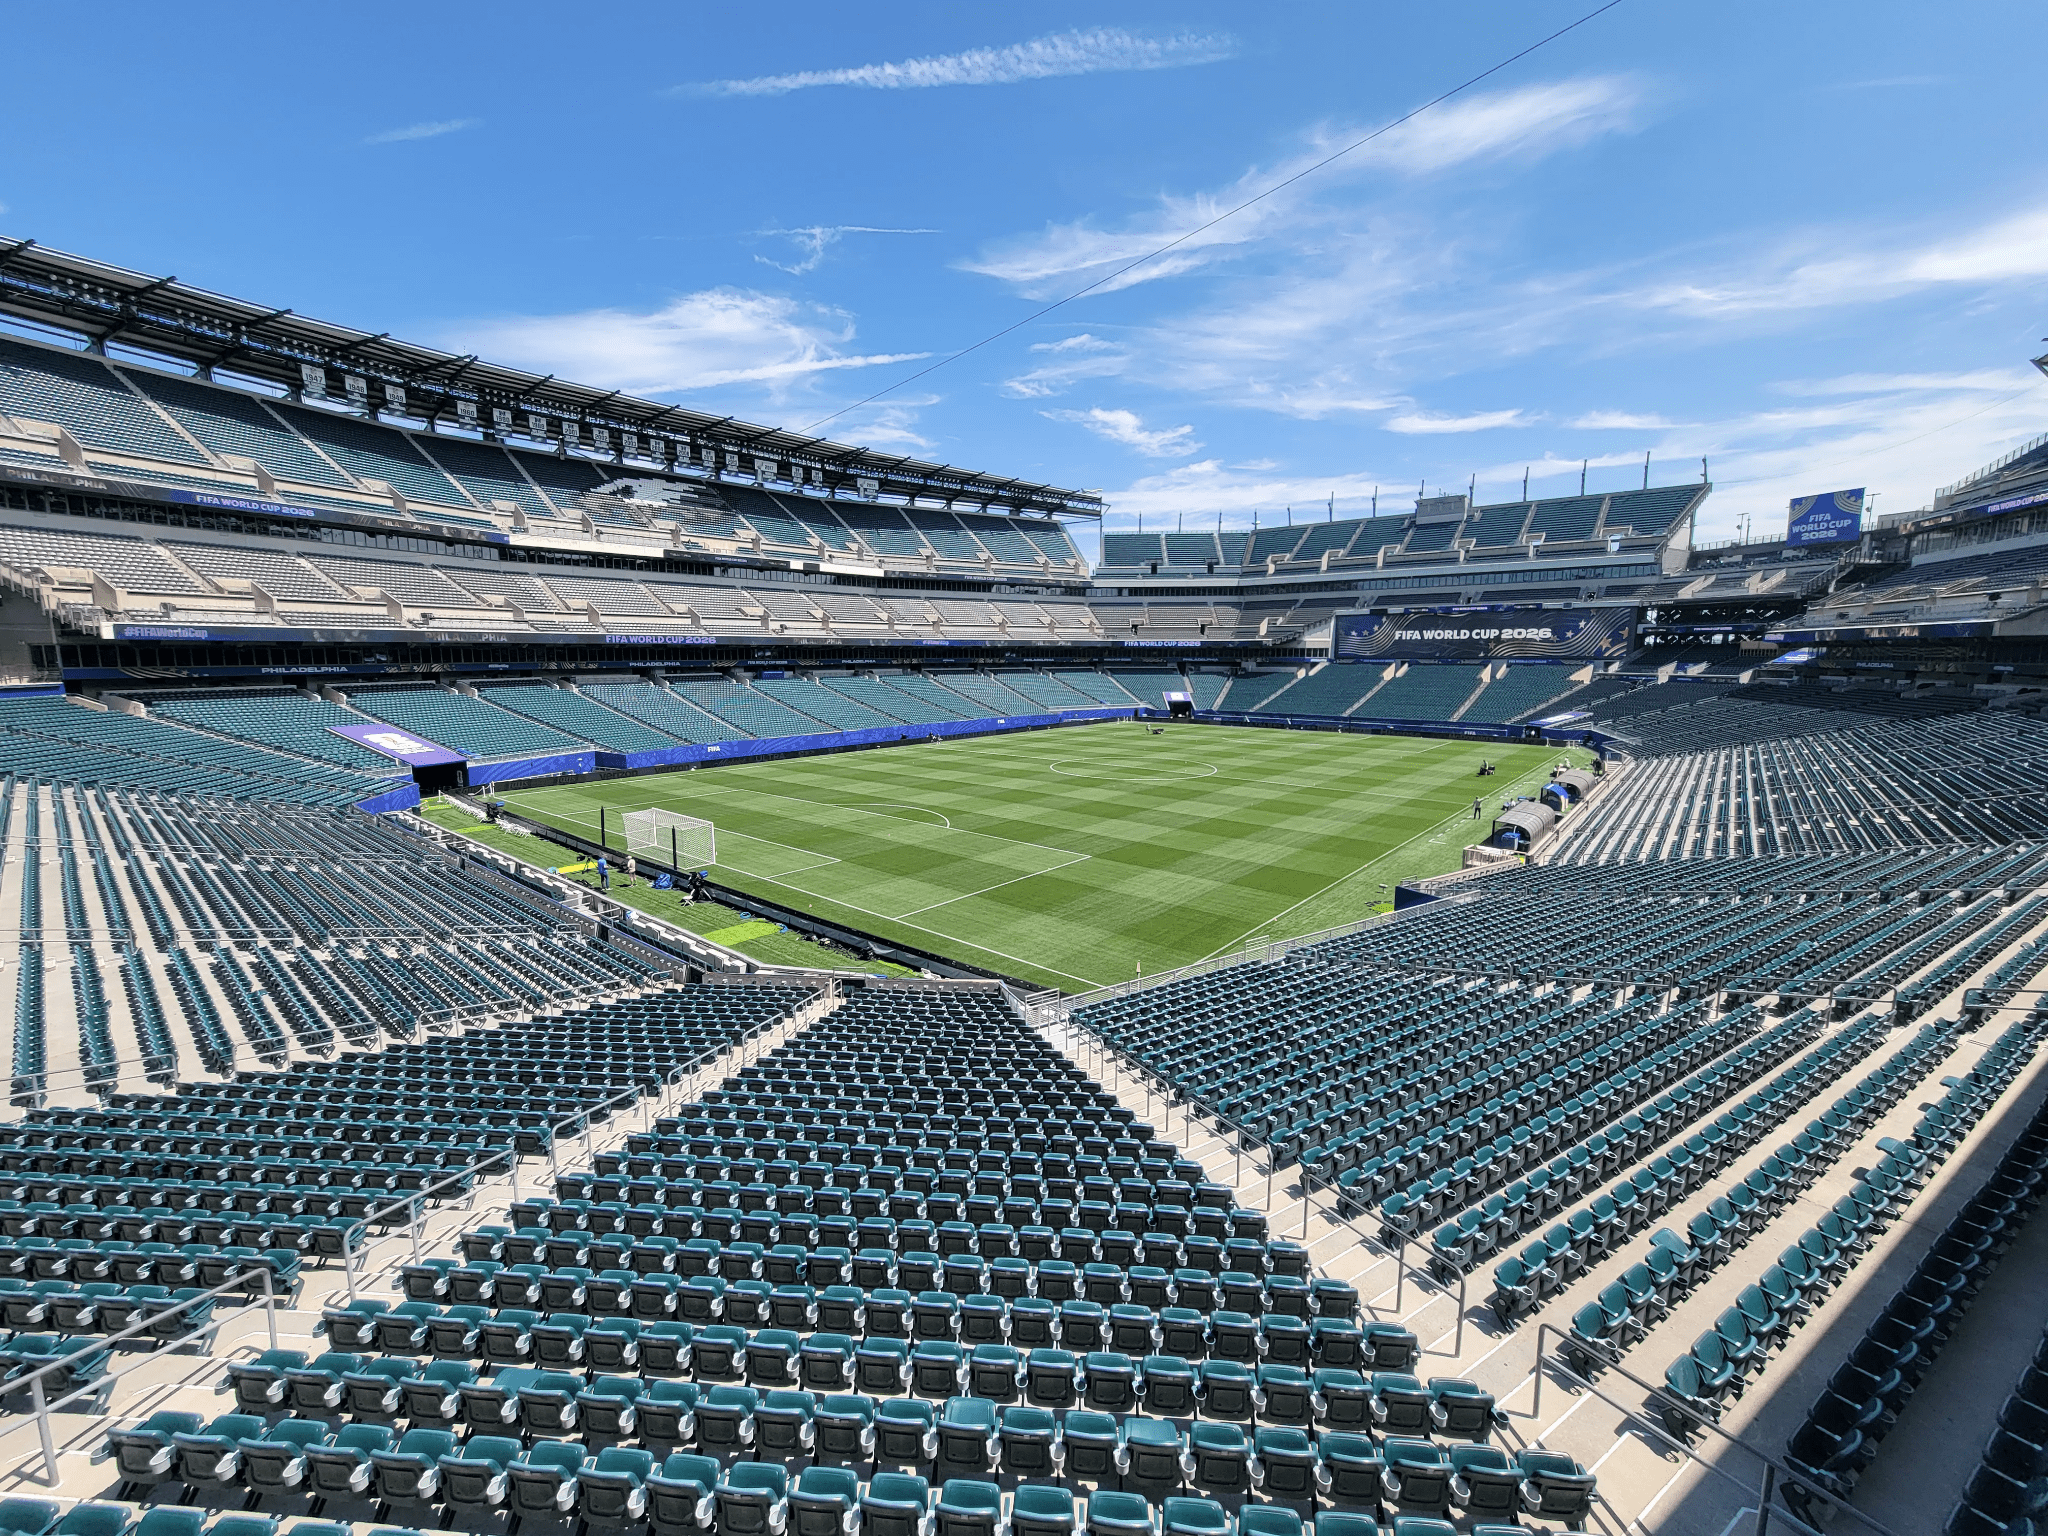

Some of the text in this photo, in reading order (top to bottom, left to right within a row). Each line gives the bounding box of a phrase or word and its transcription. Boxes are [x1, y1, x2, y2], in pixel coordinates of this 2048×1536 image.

[305, 372, 323, 384] 1947
[348, 383, 364, 393] 1948
[388, 392, 404, 402] 1949
[6, 469, 107, 490] PHILADELPHIA
[196, 495, 315, 516] FIFA WORLD CUP 2026
[2000, 500, 2021, 509] WORLD
[1809, 513, 1831, 522] FIFA
[377, 519, 430, 532] PHILALPHIA
[1792, 519, 1852, 533] WORLD CUP
[1801, 530, 1837, 540] 2026
[124, 626, 208, 639] #FIFAWorldCup
[1395, 628, 1552, 640] FIFA WORLD CUP 2026
[756, 753, 786, 761] ULTRA
[600, 764, 689, 780] verizon verizon
